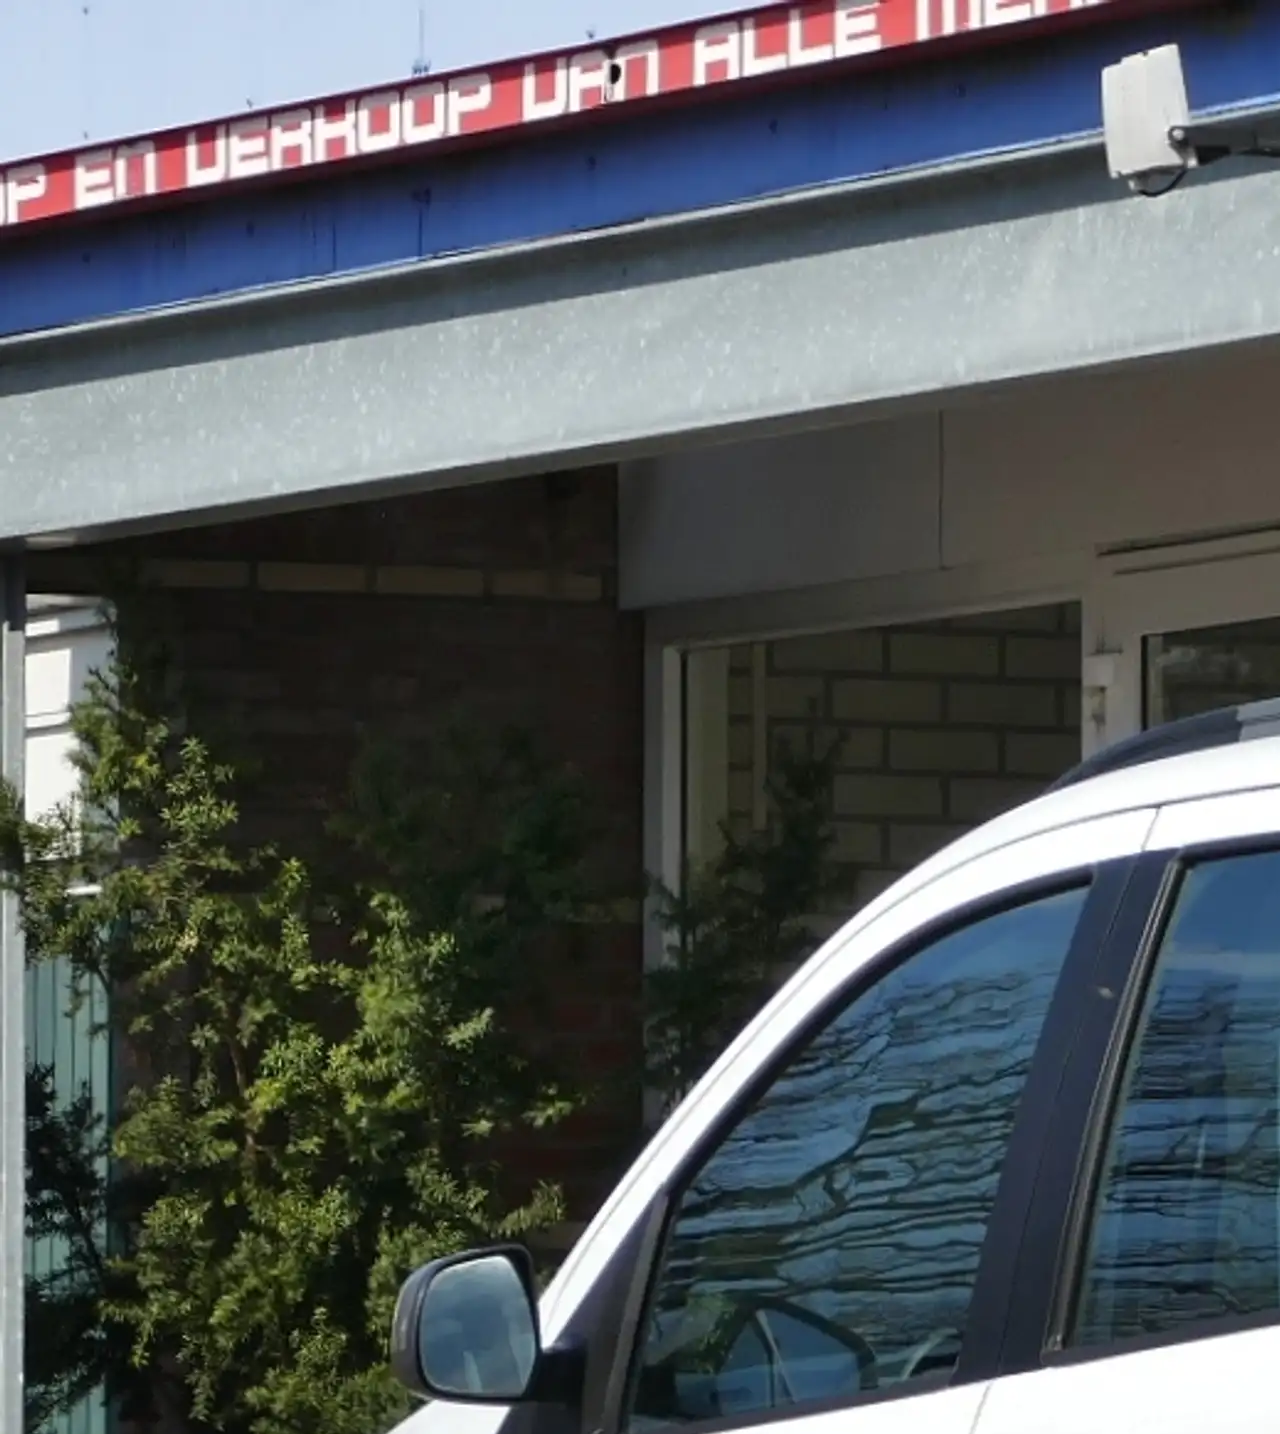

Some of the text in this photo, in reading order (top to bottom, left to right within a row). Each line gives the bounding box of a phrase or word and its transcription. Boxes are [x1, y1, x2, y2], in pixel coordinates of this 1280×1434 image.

[0, 163, 46, 226] P
[185, 74, 492, 188] VERKOOP
[523, 39, 660, 122] VAN
[693, 0, 882, 86] ALLE
